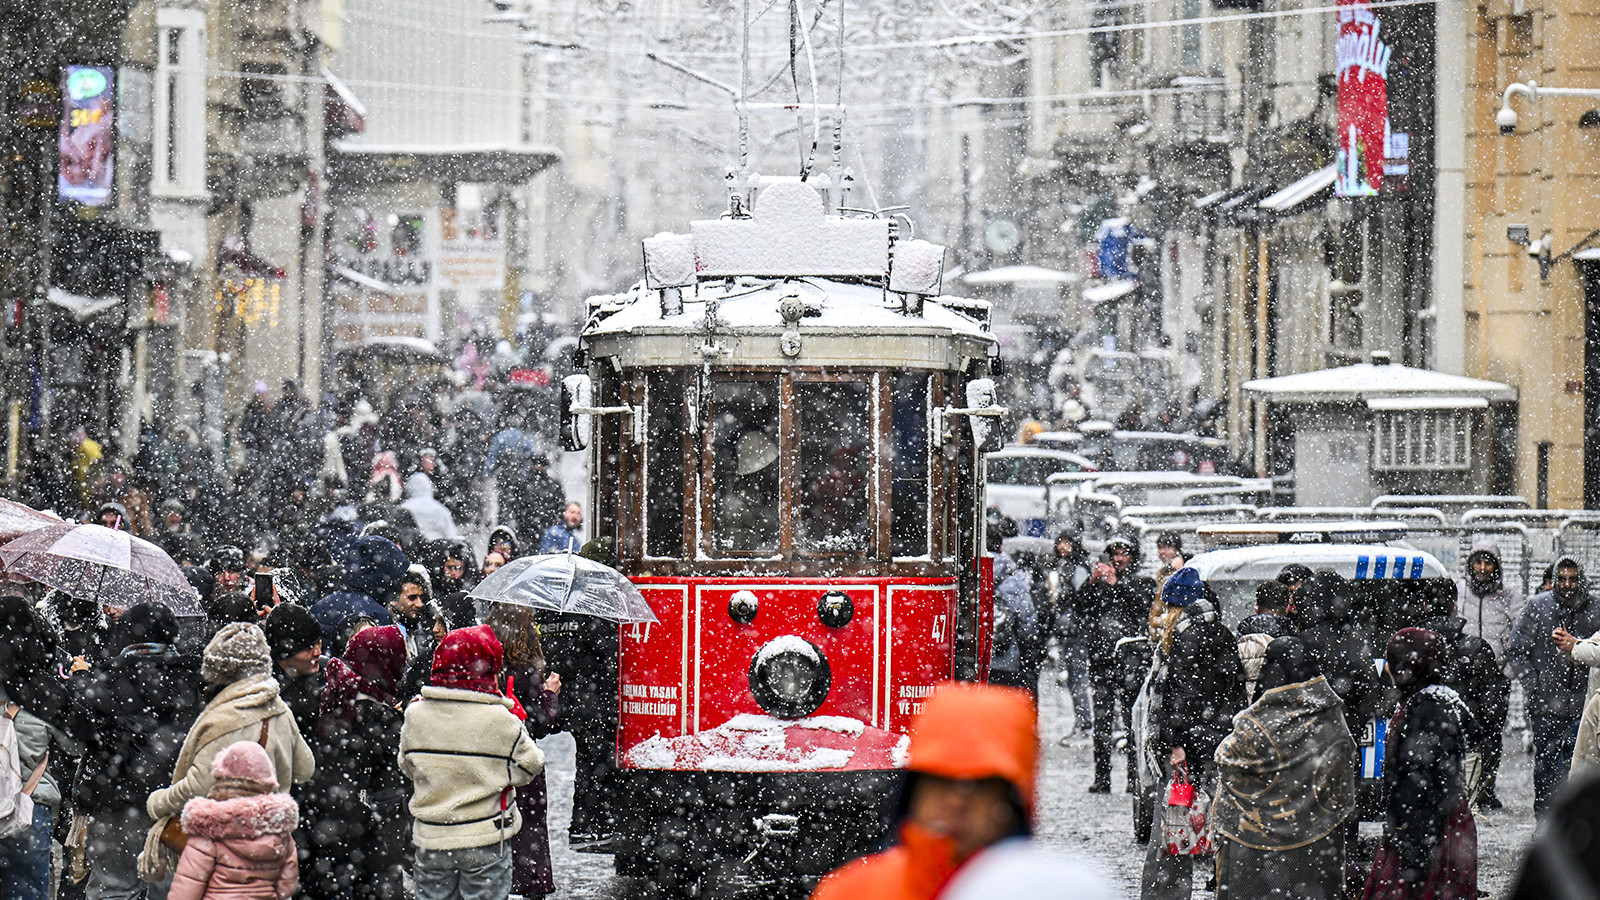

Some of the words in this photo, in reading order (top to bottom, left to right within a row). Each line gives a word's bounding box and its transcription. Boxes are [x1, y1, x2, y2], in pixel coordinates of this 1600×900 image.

[932, 614, 946, 643] 47
[649, 686, 677, 699] YASAK
[900, 685, 935, 698] ASILMAK
[629, 700, 676, 716] TEHLİKELİDİR
[899, 702, 910, 715] VE
